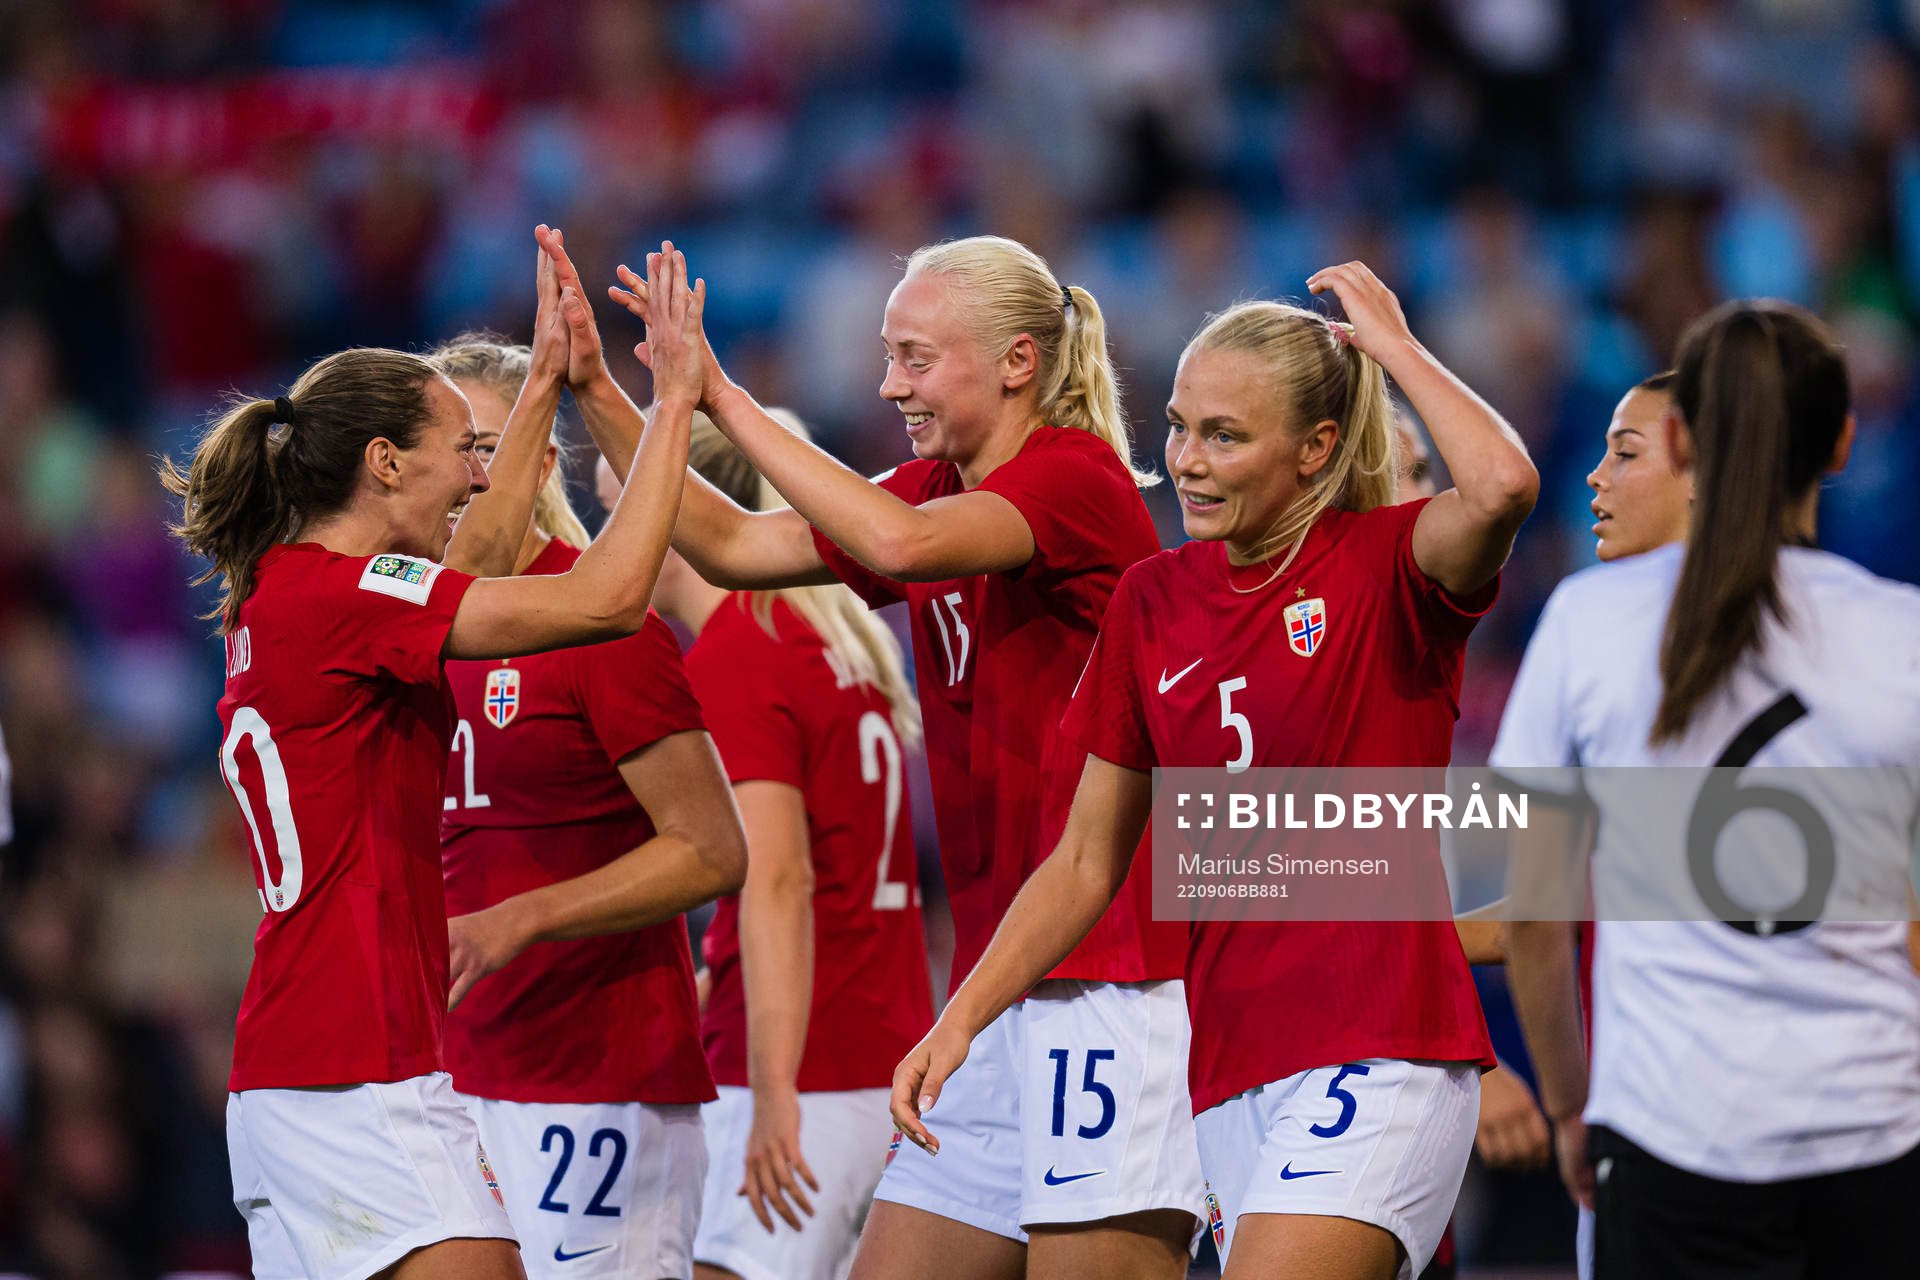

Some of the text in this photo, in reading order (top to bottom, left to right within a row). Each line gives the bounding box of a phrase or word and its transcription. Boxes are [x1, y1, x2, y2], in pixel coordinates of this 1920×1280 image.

[931, 592, 970, 687] 15
[443, 719, 491, 811] 2
[1218, 675, 1253, 774] 5
[219, 706, 303, 913] 0
[858, 710, 921, 910] 2
[1686, 690, 1837, 937] 6
[1048, 1048, 1116, 1139] 15
[1308, 1063, 1370, 1138] 5
[538, 1123, 628, 1217] 22
